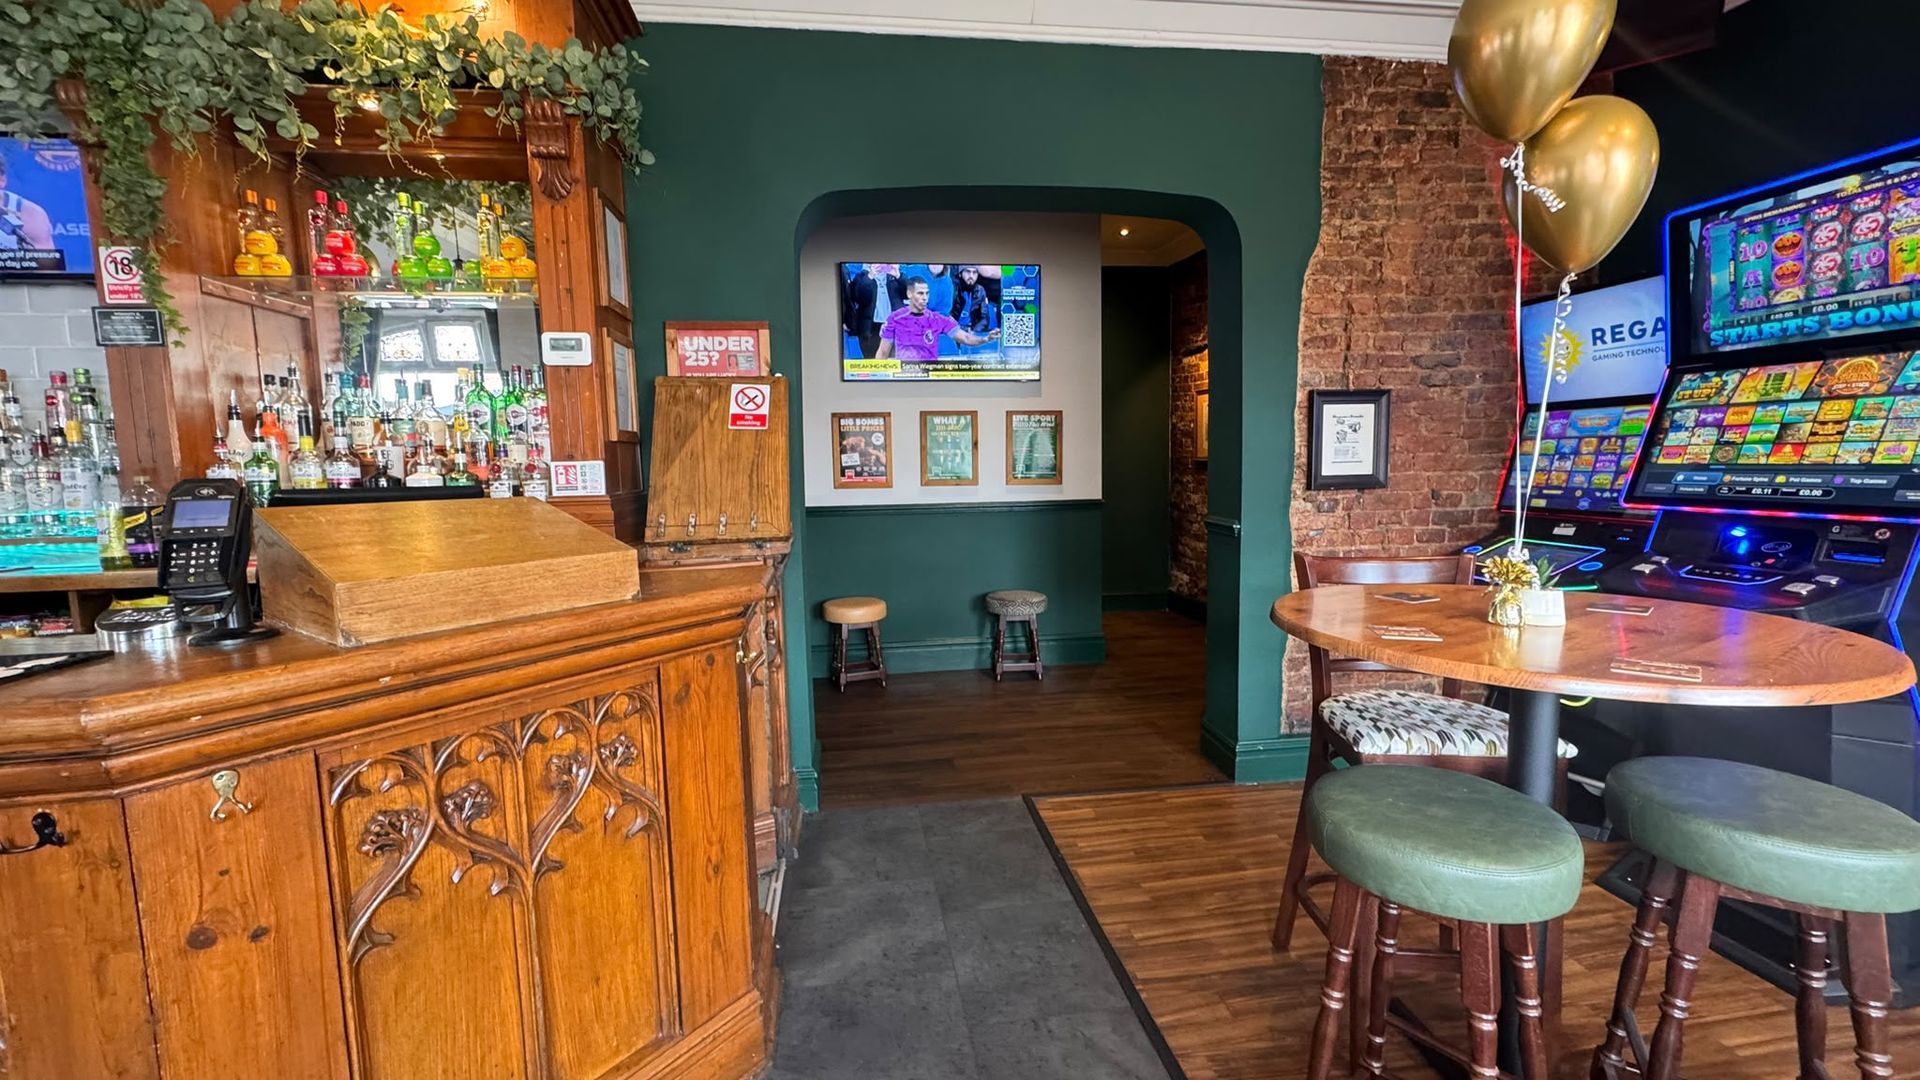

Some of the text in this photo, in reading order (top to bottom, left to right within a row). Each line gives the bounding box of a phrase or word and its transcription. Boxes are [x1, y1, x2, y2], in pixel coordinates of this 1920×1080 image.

[54, 223, 91, 236] ASE
[109, 256, 133, 275] 18
[1812, 303, 1839, 314] £0.00
[1591, 316, 1665, 346] REGA
[1710, 315, 1821, 347] STARTS
[683, 336, 755, 351] UNDER
[684, 352, 720, 366] 25?
[1592, 346, 1665, 362] GAMING TECHNOL
[933, 416, 957, 425] WHAT
